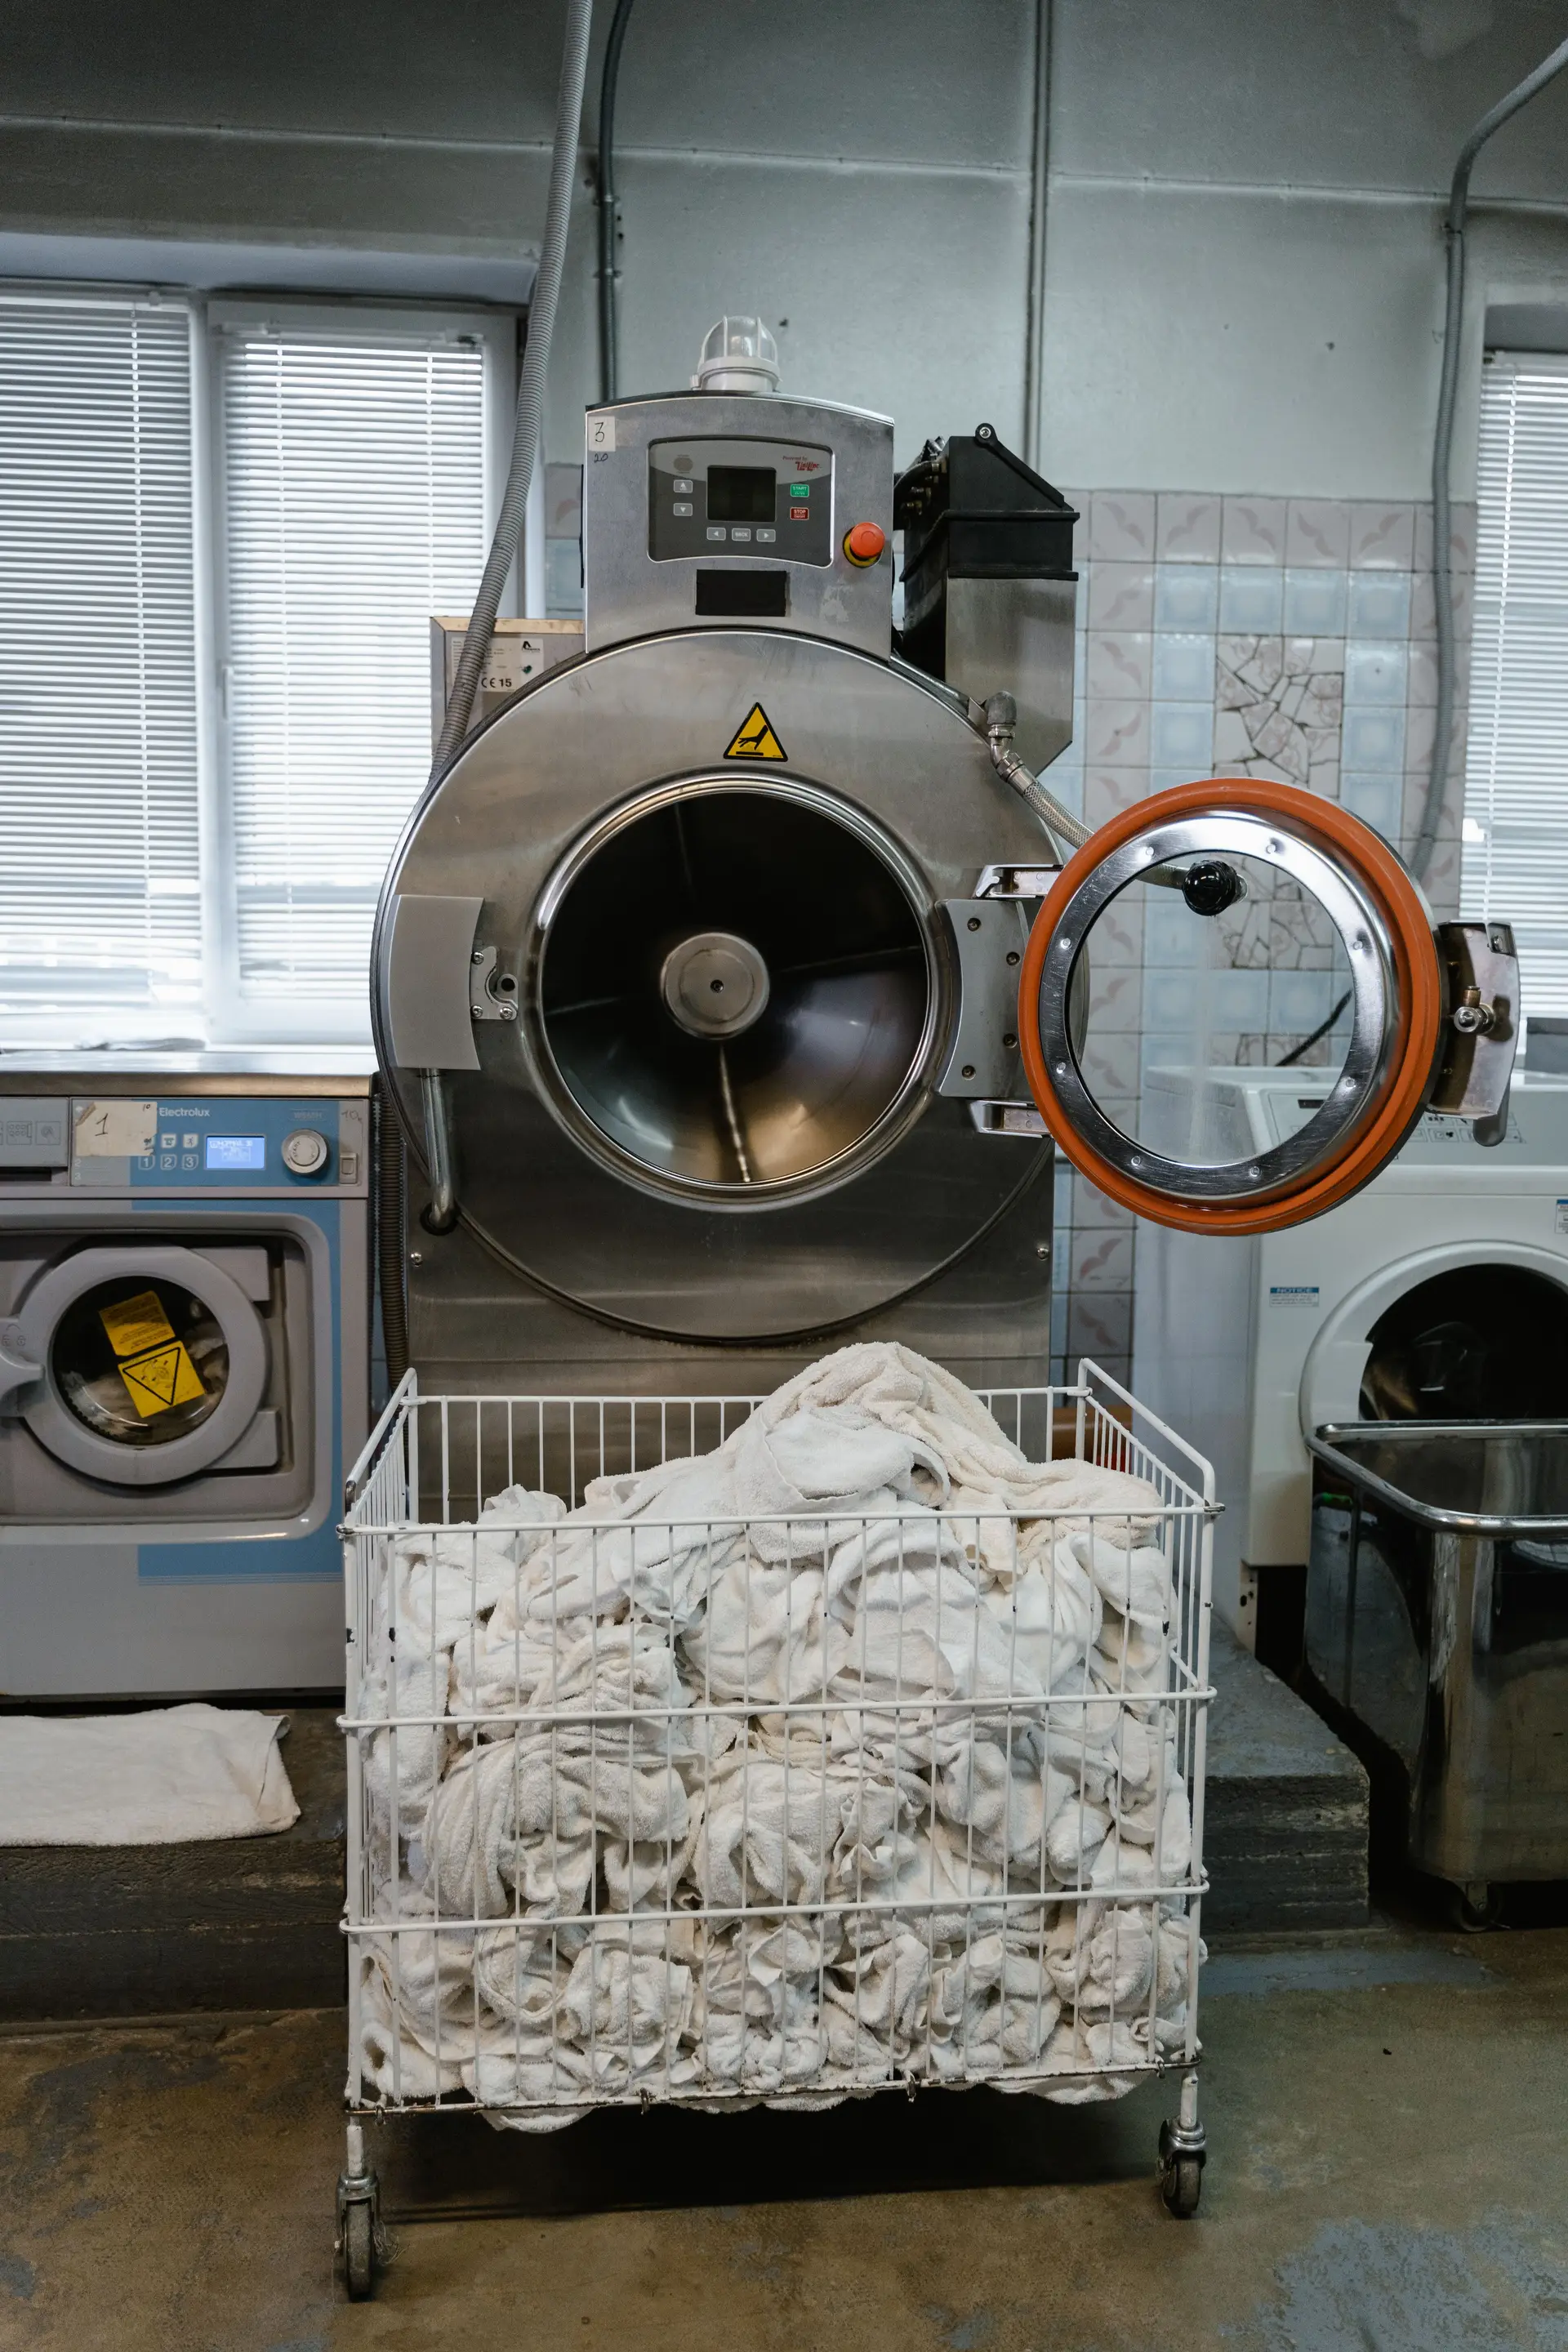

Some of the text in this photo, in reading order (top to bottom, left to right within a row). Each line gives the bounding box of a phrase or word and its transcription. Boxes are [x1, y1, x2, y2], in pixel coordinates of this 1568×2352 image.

[595, 421, 605, 443] 3
[499, 679, 512, 688] 15
[158, 1107, 210, 1117] Electrolux
[95, 1113, 108, 1136] 1
[74, 1159, 81, 1167] 2
[144, 1157, 149, 1168] 1
[164, 1156, 173, 1168] 2
[185, 1156, 194, 1168] 3
[74, 1172, 81, 1180] 3
